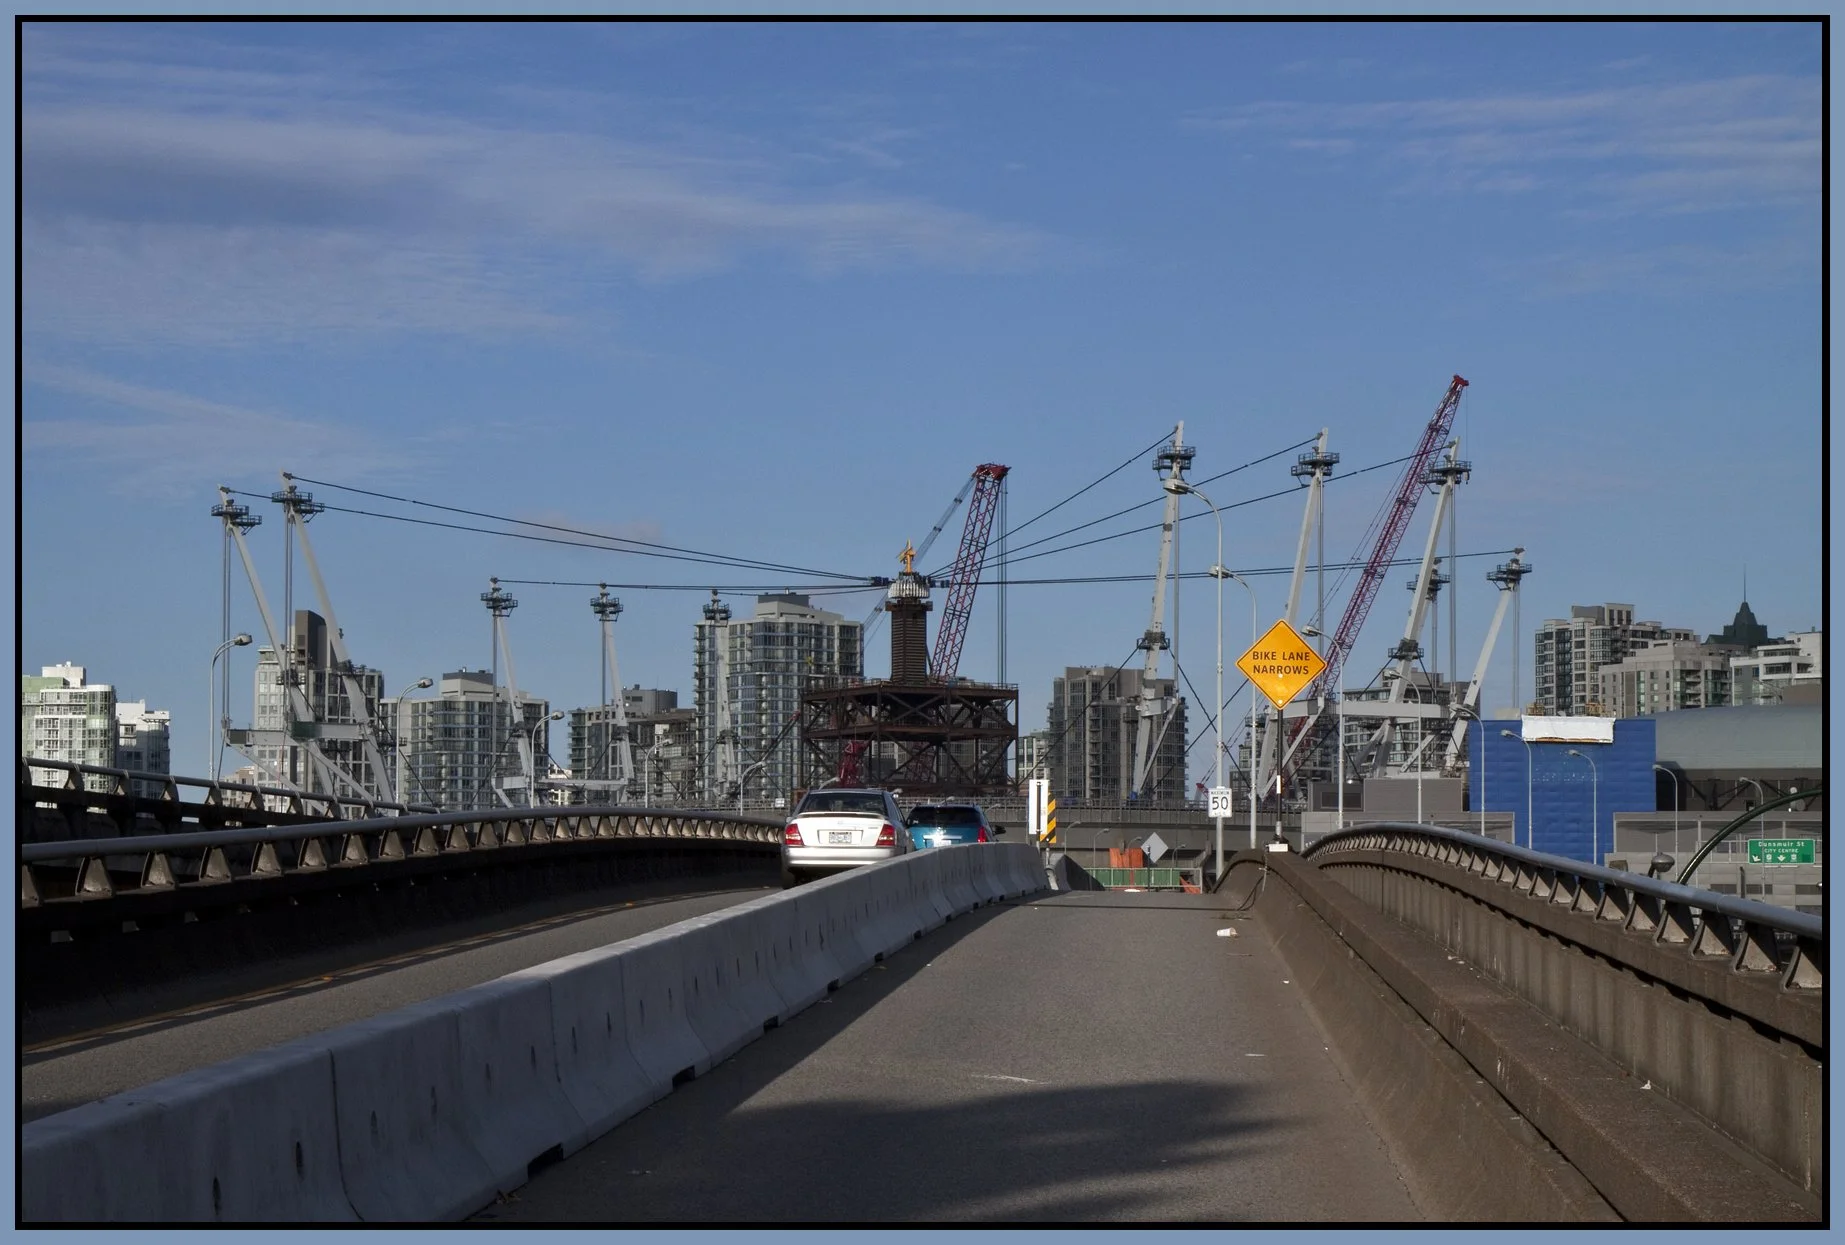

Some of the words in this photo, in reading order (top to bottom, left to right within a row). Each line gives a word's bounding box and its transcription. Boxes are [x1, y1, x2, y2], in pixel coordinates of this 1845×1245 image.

[1252, 651, 1277, 660] BIKE
[1282, 652, 1310, 661] LANE
[1253, 665, 1309, 675] NARROWS
[1212, 796, 1228, 810] 50
